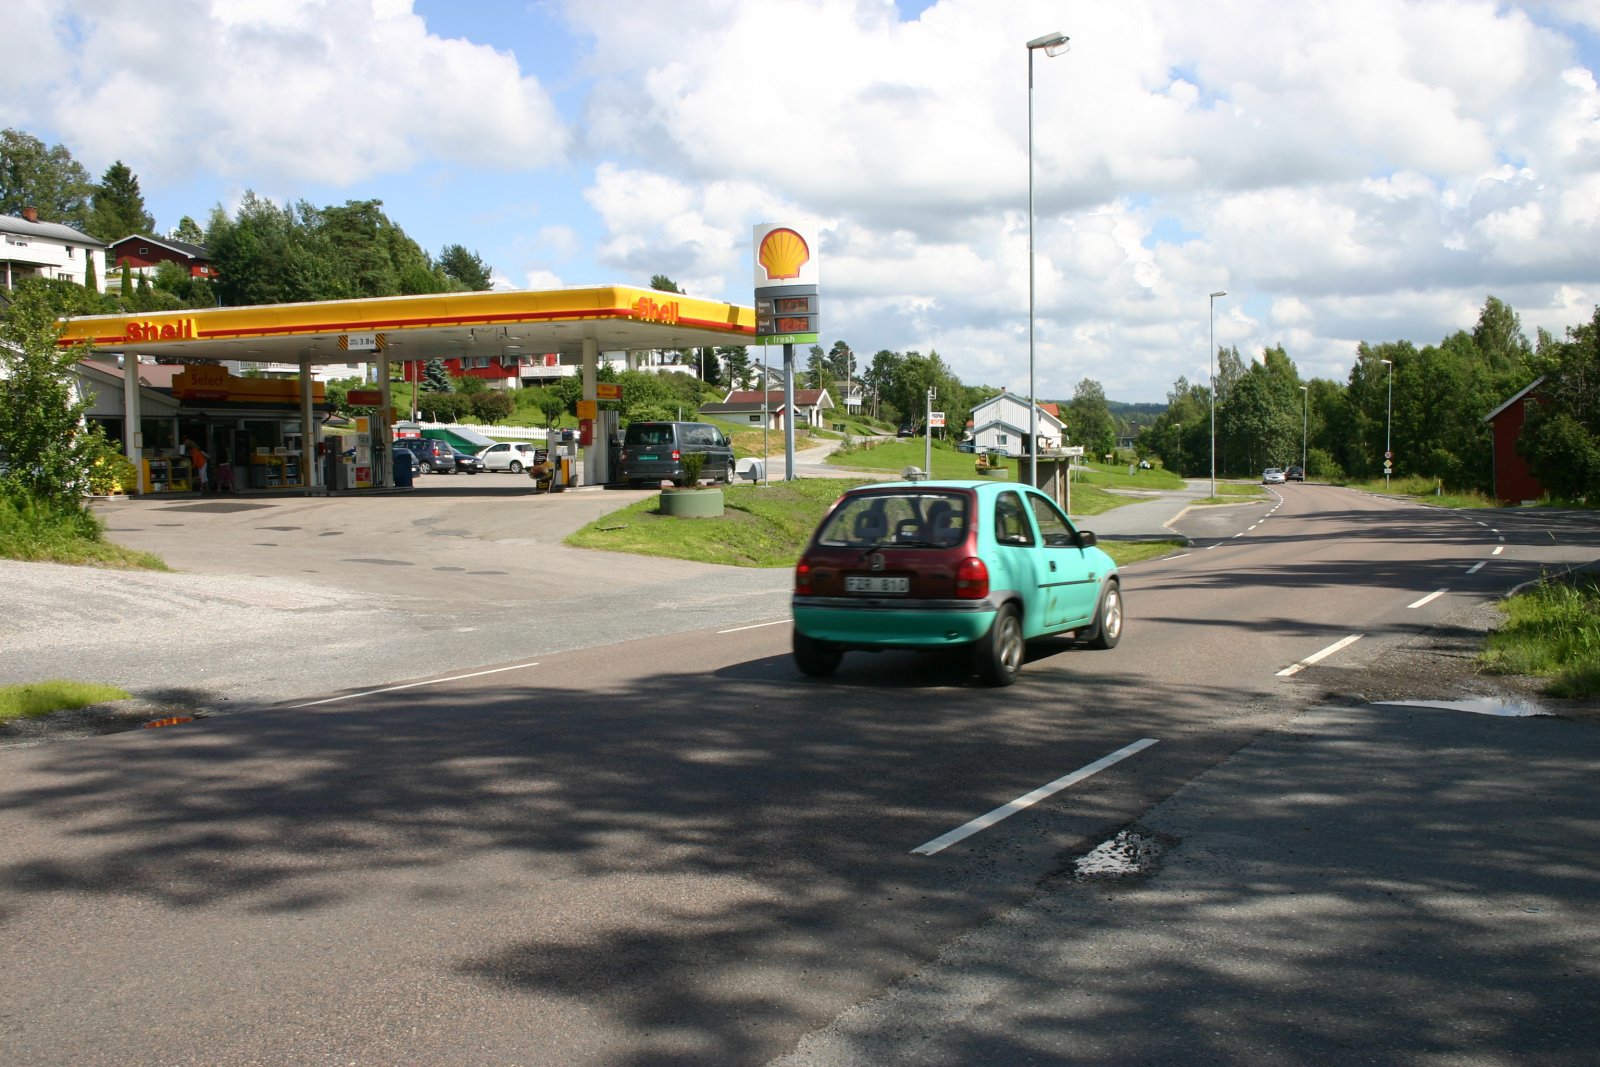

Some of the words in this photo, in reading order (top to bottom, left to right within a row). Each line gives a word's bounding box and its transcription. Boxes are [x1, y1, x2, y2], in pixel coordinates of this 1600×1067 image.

[639, 296, 679, 321] Shell
[126, 319, 192, 341] Shell
[773, 335, 795, 344] fresh
[191, 373, 223, 387] Select
